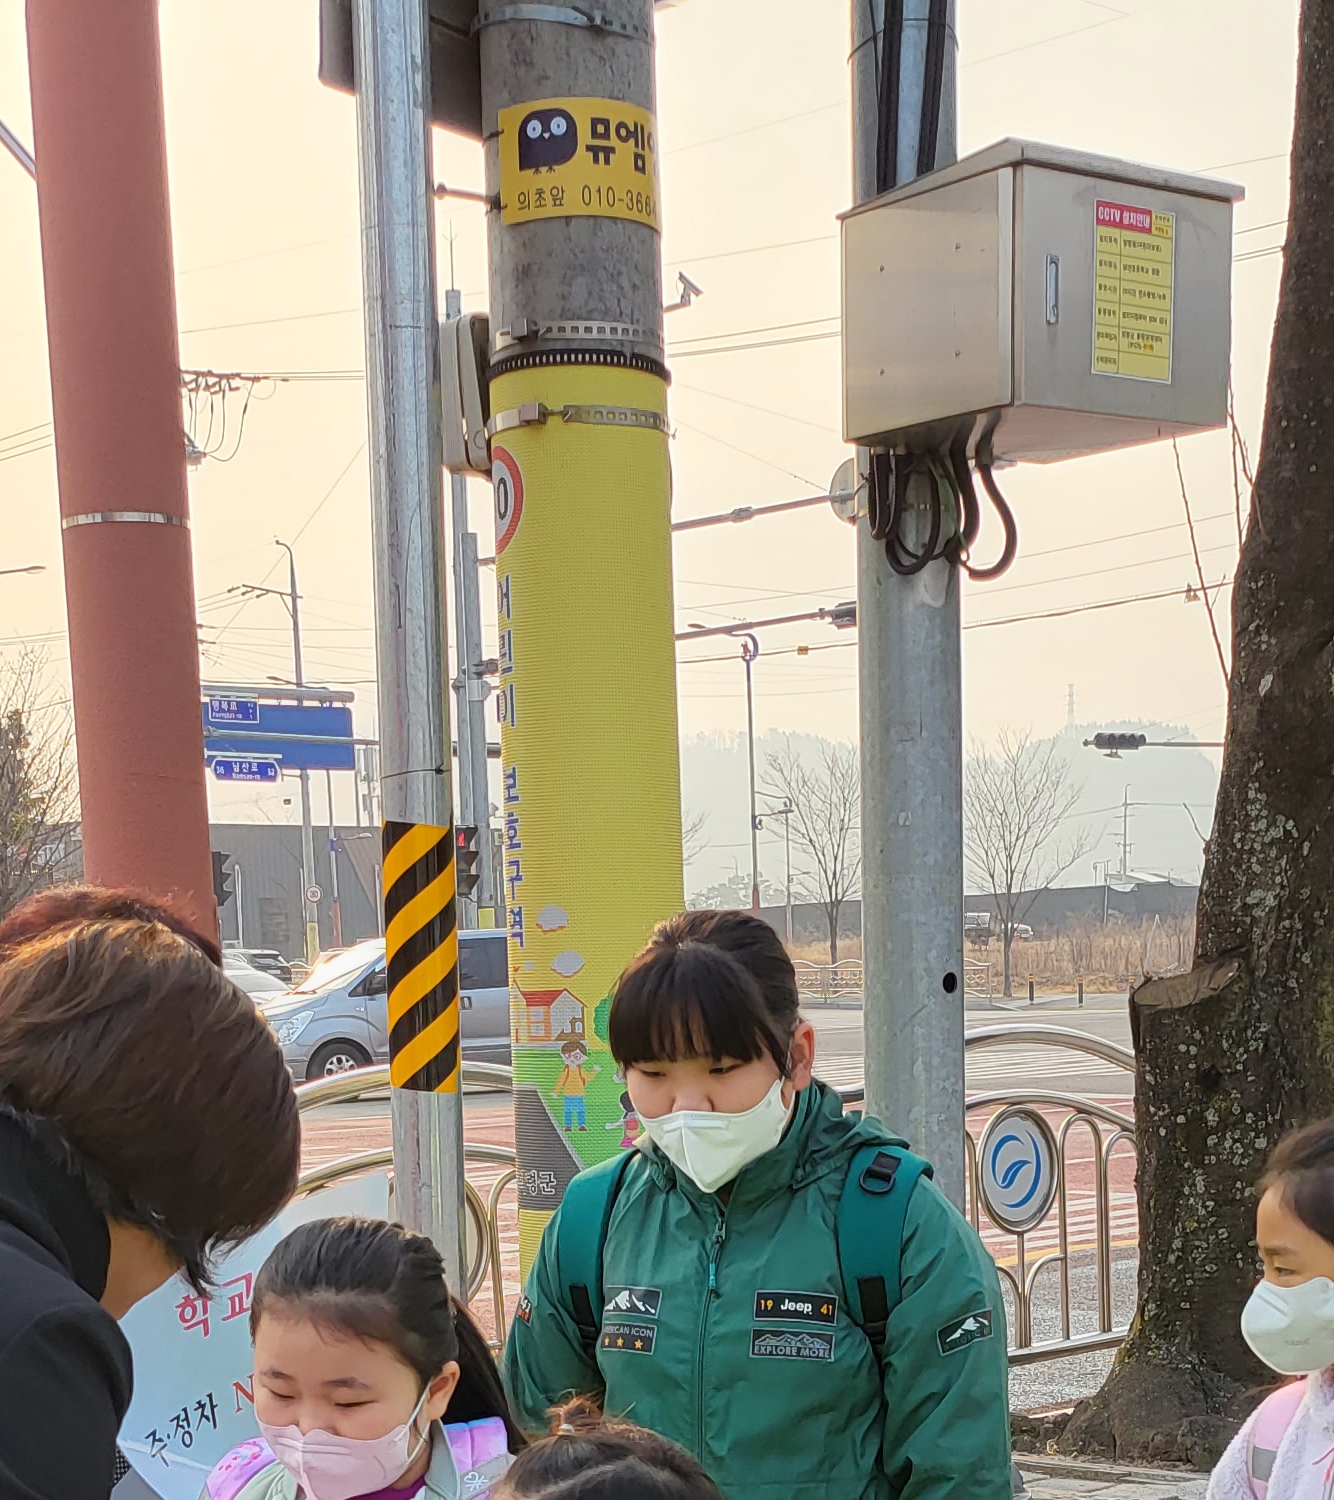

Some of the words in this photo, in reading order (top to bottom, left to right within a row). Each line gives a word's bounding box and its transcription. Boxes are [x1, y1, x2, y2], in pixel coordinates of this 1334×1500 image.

[517, 185, 566, 211] 의초앞
[1098, 206, 1121, 223] CCTV
[496, 476, 509, 521] 0
[232, 761, 259, 773] 남산로
[760, 1299, 774, 1311] 19
[780, 1298, 813, 1315] Jeep
[820, 1303, 833, 1316] 41
[631, 1326, 654, 1338] ICON
[754, 1345, 798, 1356] EXPLORE
[800, 1347, 831, 1358] MORE
